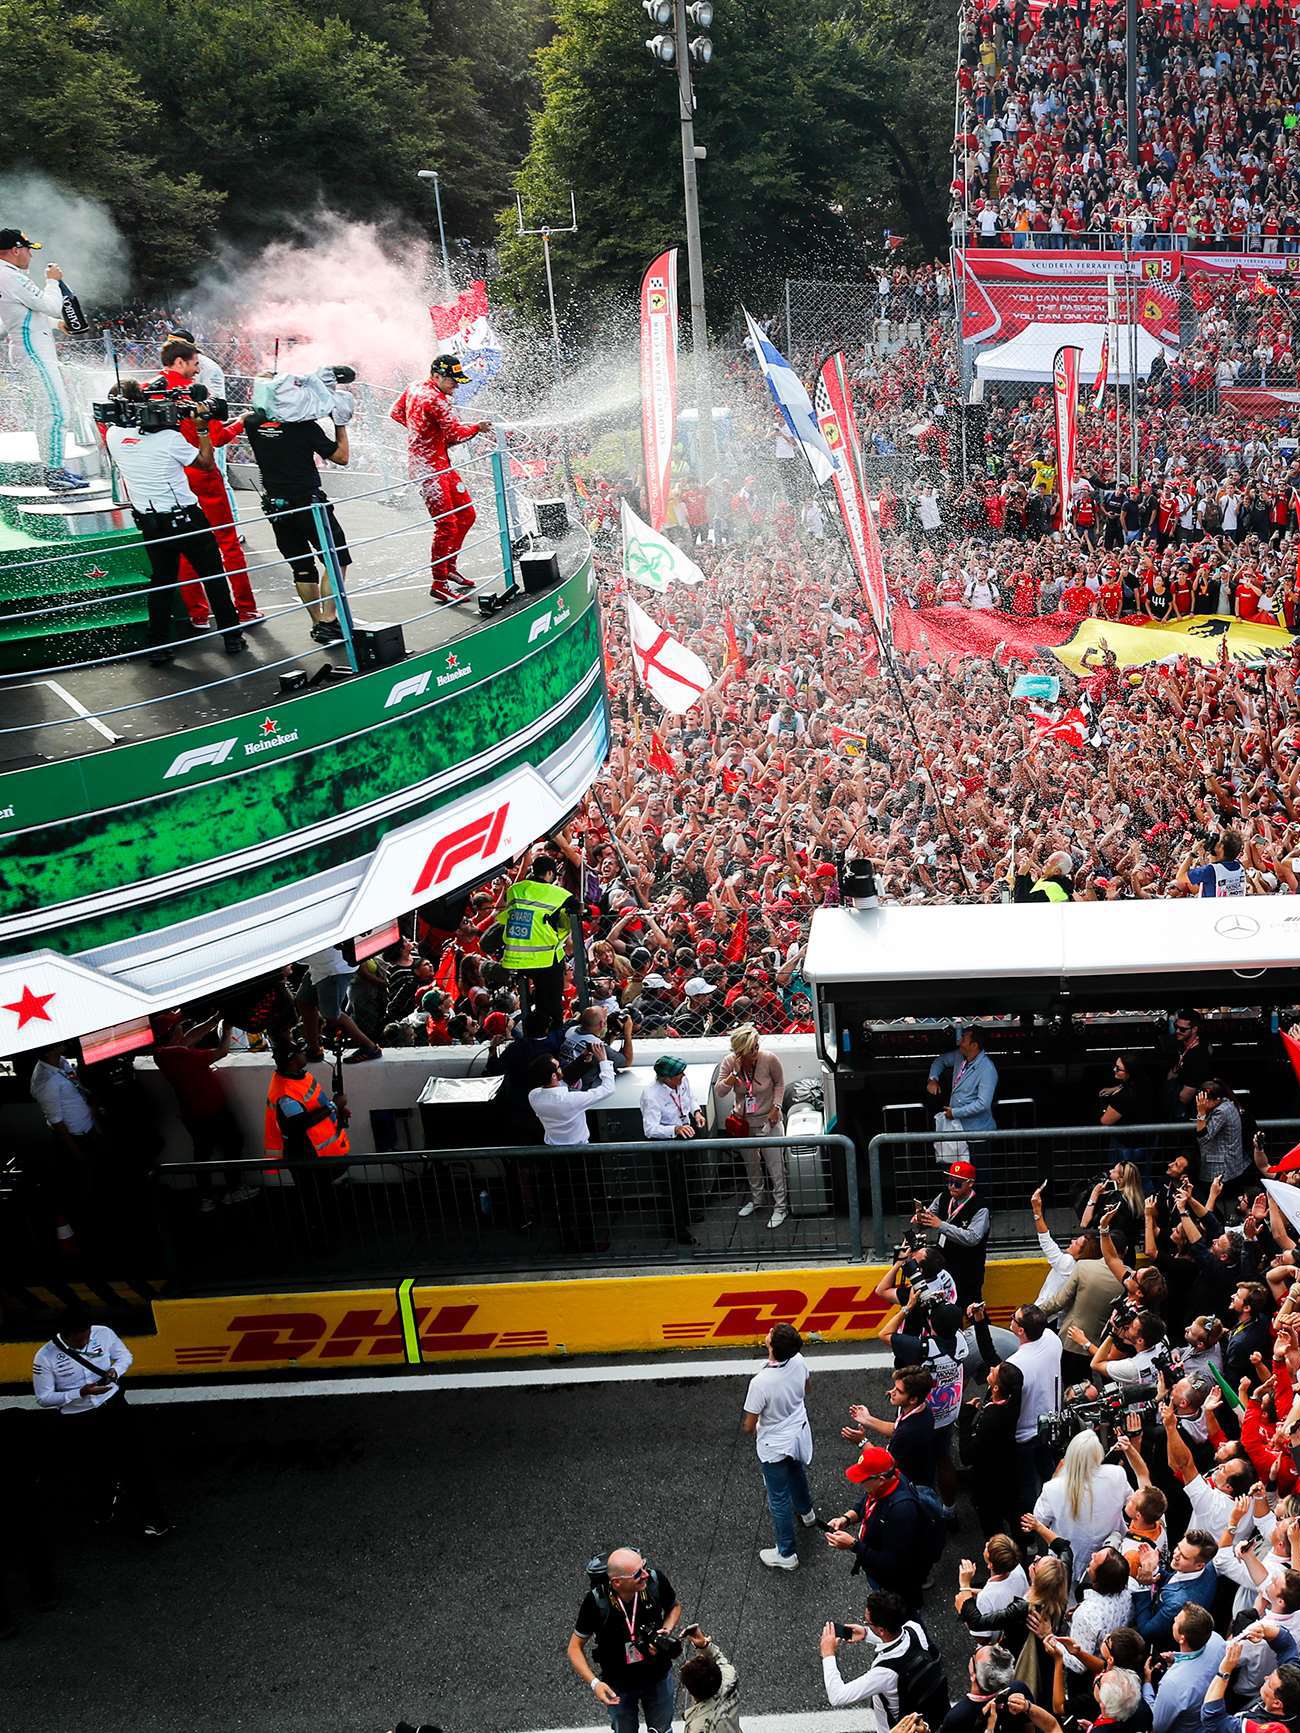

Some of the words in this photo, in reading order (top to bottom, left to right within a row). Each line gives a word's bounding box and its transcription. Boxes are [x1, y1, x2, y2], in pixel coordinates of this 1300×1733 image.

[1151, 595, 1166, 607] 44
[528, 611, 552, 643] F1
[384, 670, 433, 709] F1
[436, 663, 473, 687] Heineken
[162, 737, 239, 780] F1
[243, 728, 299, 757] Heineken
[411, 801, 511, 896] F1
[227, 1305, 498, 1363] DHL
[713, 1286, 895, 1337] DH
